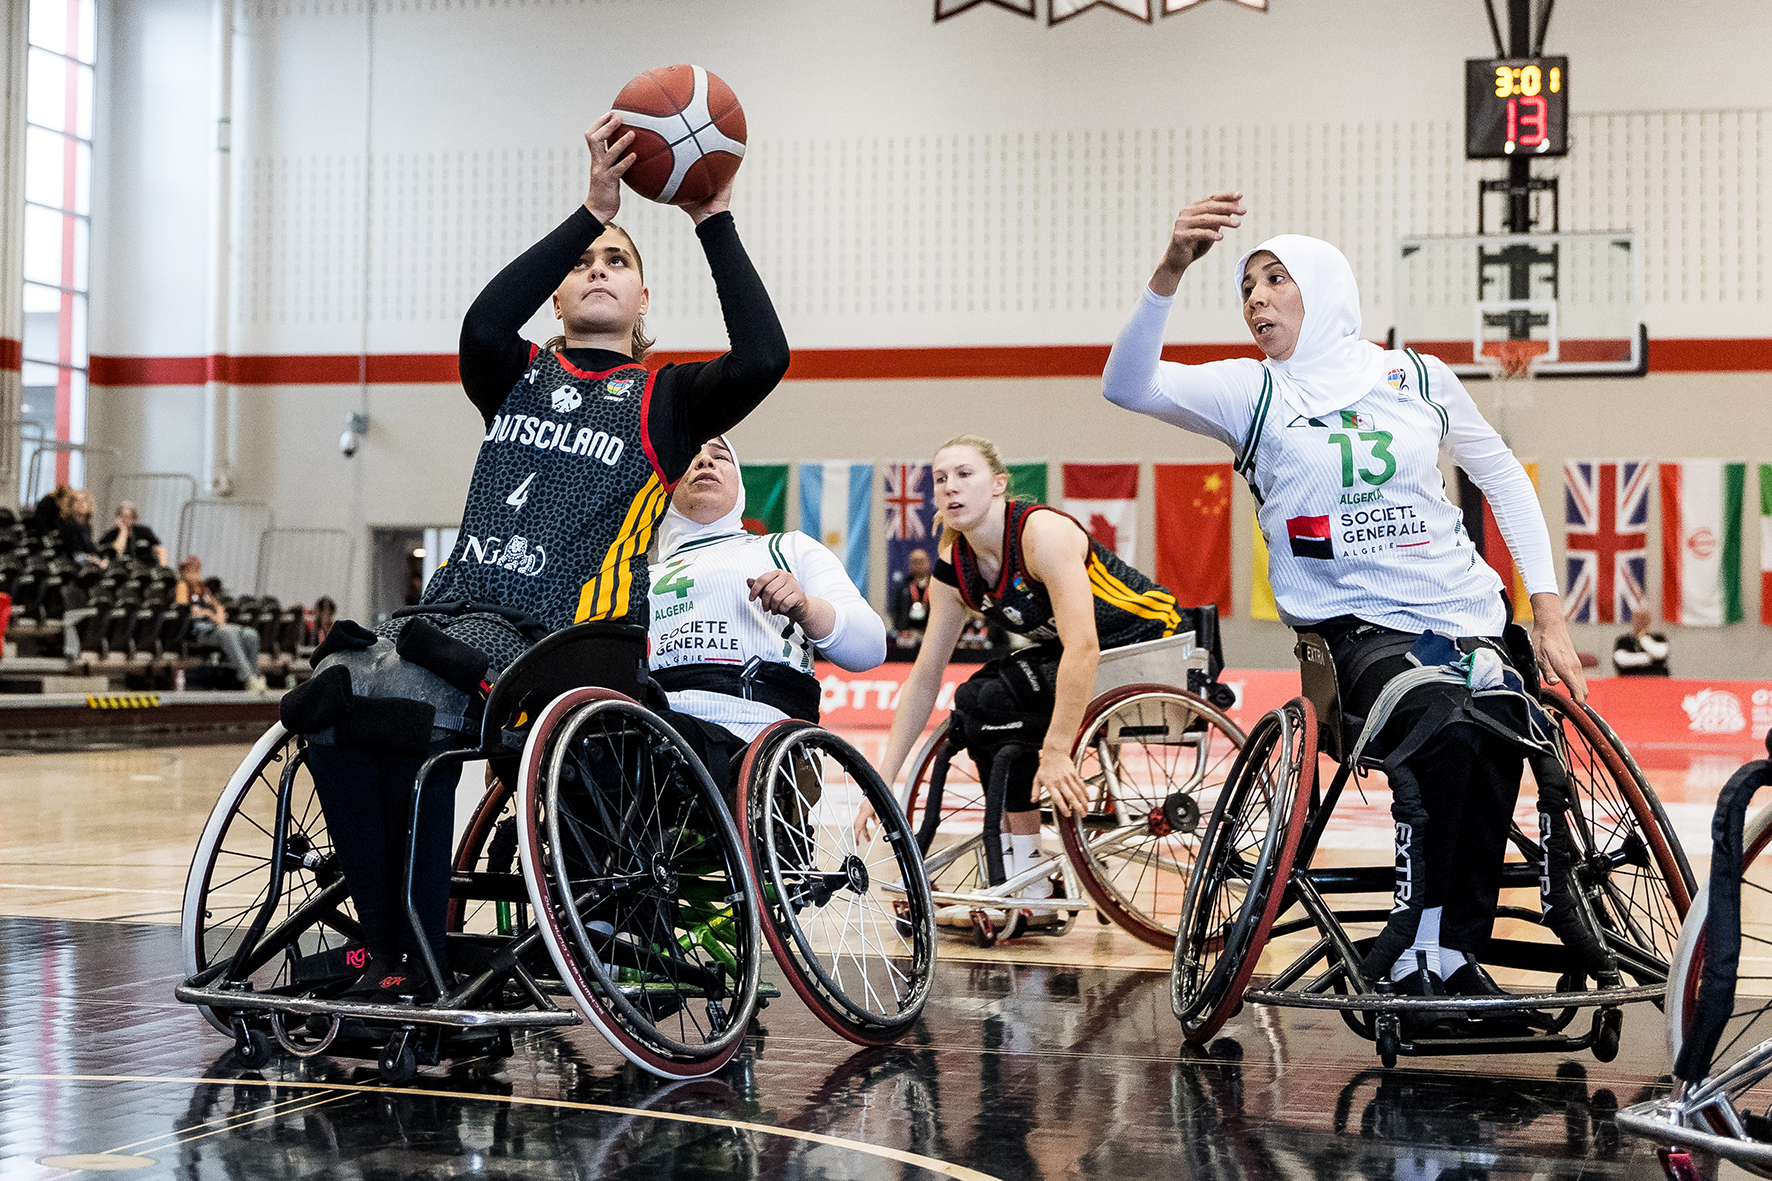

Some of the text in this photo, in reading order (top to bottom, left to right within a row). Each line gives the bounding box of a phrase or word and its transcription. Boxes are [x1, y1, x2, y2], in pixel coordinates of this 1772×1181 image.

[1495, 65, 1561, 98] 3:01
[1506, 95, 1548, 145] 13
[484, 414, 625, 467] DUTSCLAND
[1327, 430, 1397, 488] 13
[506, 471, 537, 513] 4
[1339, 488, 1385, 505] ALGERIA
[1340, 505, 1417, 527] SOCIETE
[1342, 521, 1427, 544] GENERALE
[1342, 542, 1395, 558] ALGERIE
[652, 562, 695, 600] 4
[655, 600, 694, 622] ALGERIA
[656, 637, 739, 657] GENERALE
[659, 620, 728, 645] SOCIETE
[1389, 822, 1413, 914] EXTRA
[568, 959, 605, 1015] SCHWALBE
